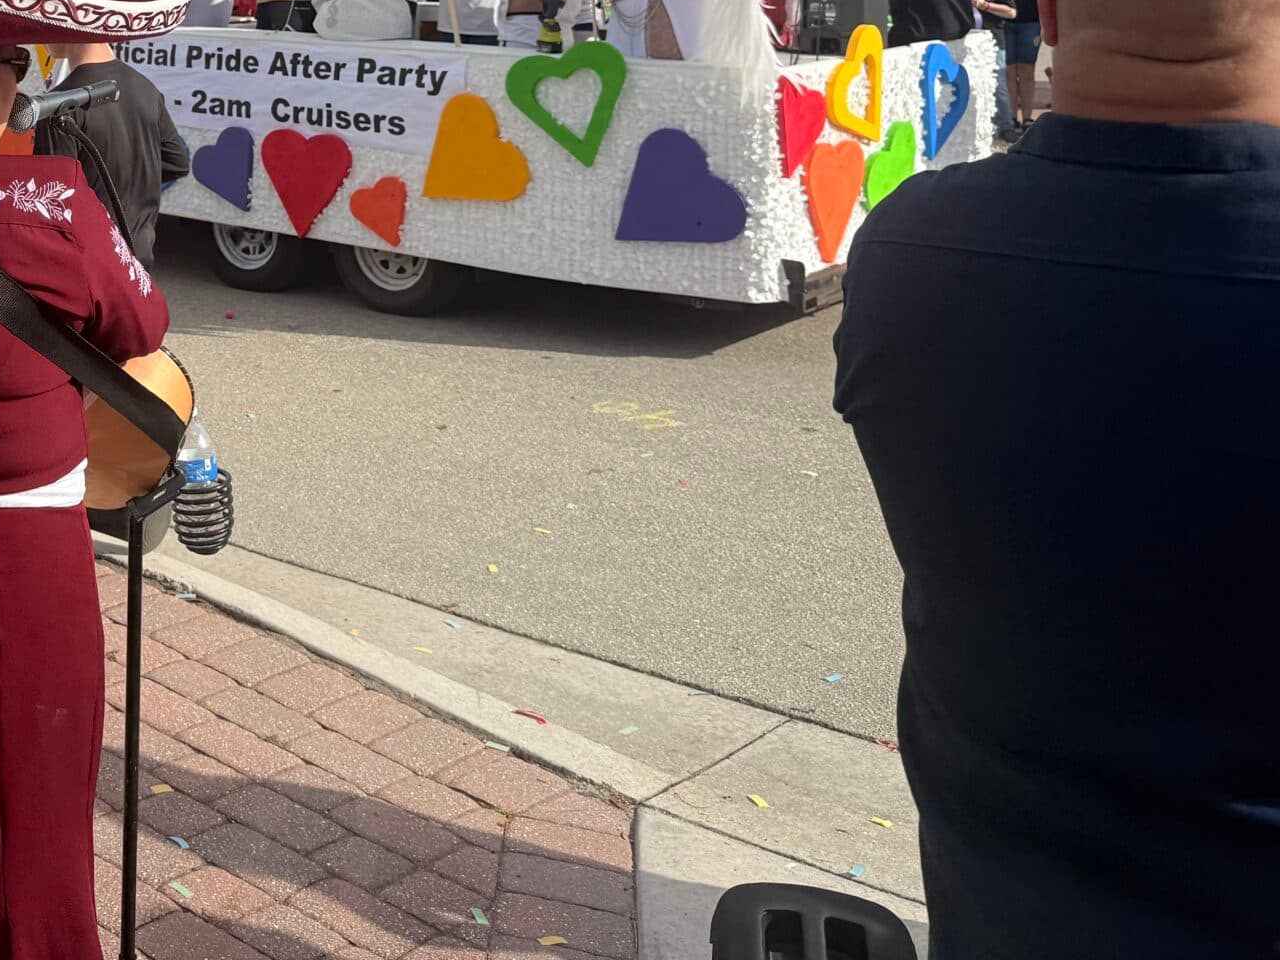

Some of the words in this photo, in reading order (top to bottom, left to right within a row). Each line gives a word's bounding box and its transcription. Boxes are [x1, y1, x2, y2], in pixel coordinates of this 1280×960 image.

[111, 41, 176, 67] ficial
[186, 45, 259, 74] Pride
[268, 51, 347, 81] After
[357, 57, 448, 96] Party
[191, 89, 251, 118] 2am
[271, 97, 405, 136] Cruisers
